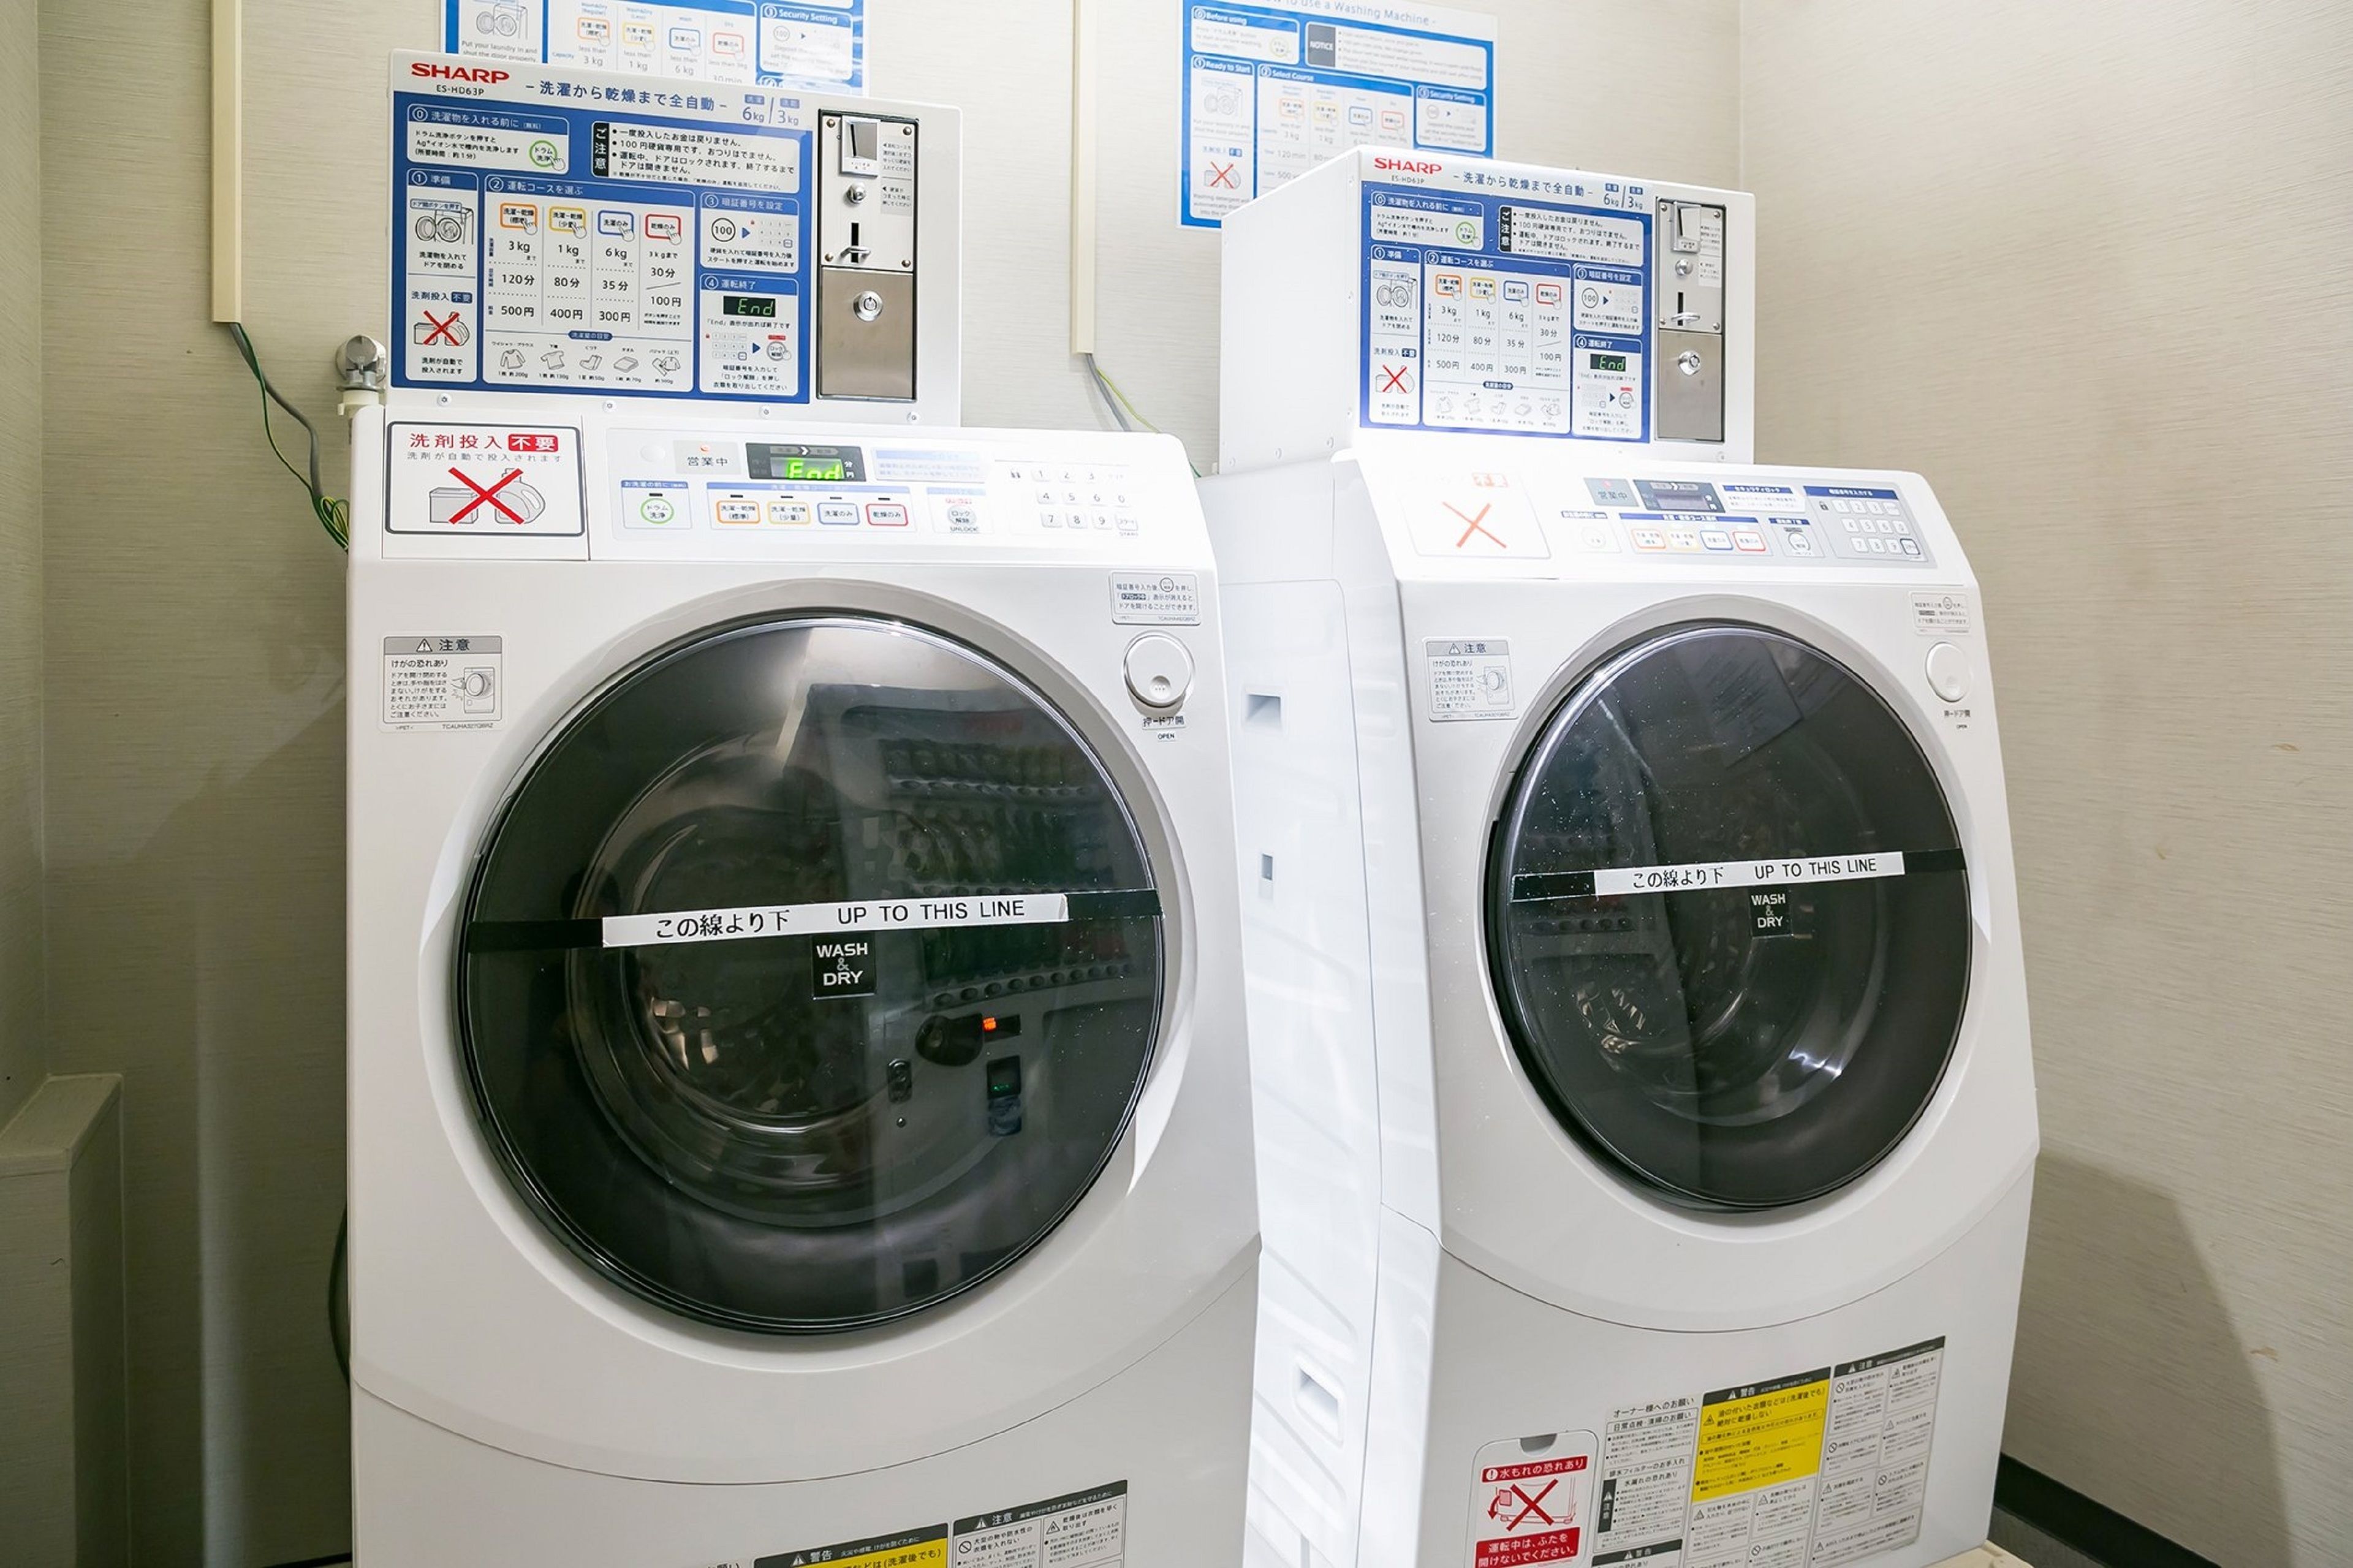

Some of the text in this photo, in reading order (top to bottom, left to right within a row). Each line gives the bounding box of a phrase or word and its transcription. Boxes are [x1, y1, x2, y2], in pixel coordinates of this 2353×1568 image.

[779, 9, 838, 24] Security Setting
[1334, 2, 1381, 20] Washing
[1384, 10, 1430, 25] Machine
[1309, 40, 1335, 51] NOTICE
[411, 62, 510, 84] SHARP
[436, 85, 485, 96] ES-HD63P
[1374, 157, 1442, 175] SHARP
[714, 225, 732, 235] 100
[738, 298, 774, 316] End
[1599, 355, 1624, 370] End
[409, 433, 556, 451] 洗剤投入 不要
[407, 452, 561, 462] 洗剤が自動で投入されます
[687, 456, 729, 466] 営業中
[788, 461, 842, 479] End
[439, 638, 470, 651] 注意
[392, 659, 448, 668] けがの恐れあり
[1755, 857, 1877, 880] UP TO THIS LINE
[1632, 866, 1724, 890] この線より下
[1751, 893, 1786, 906] WASH
[837, 900, 1025, 925] UP TO THIS LINE
[1765, 905, 1775, 916] &
[656, 909, 789, 939] この線より下
[1757, 915, 1784, 929] DRY
[816, 942, 869, 958] WASH
[836, 957, 850, 972] &
[822, 970, 864, 987] DRY
[1499, 1458, 1584, 1479] 水もれの恐れあり
[991, 1512, 1013, 1526] 注意
[810, 1550, 833, 1562] 警告
